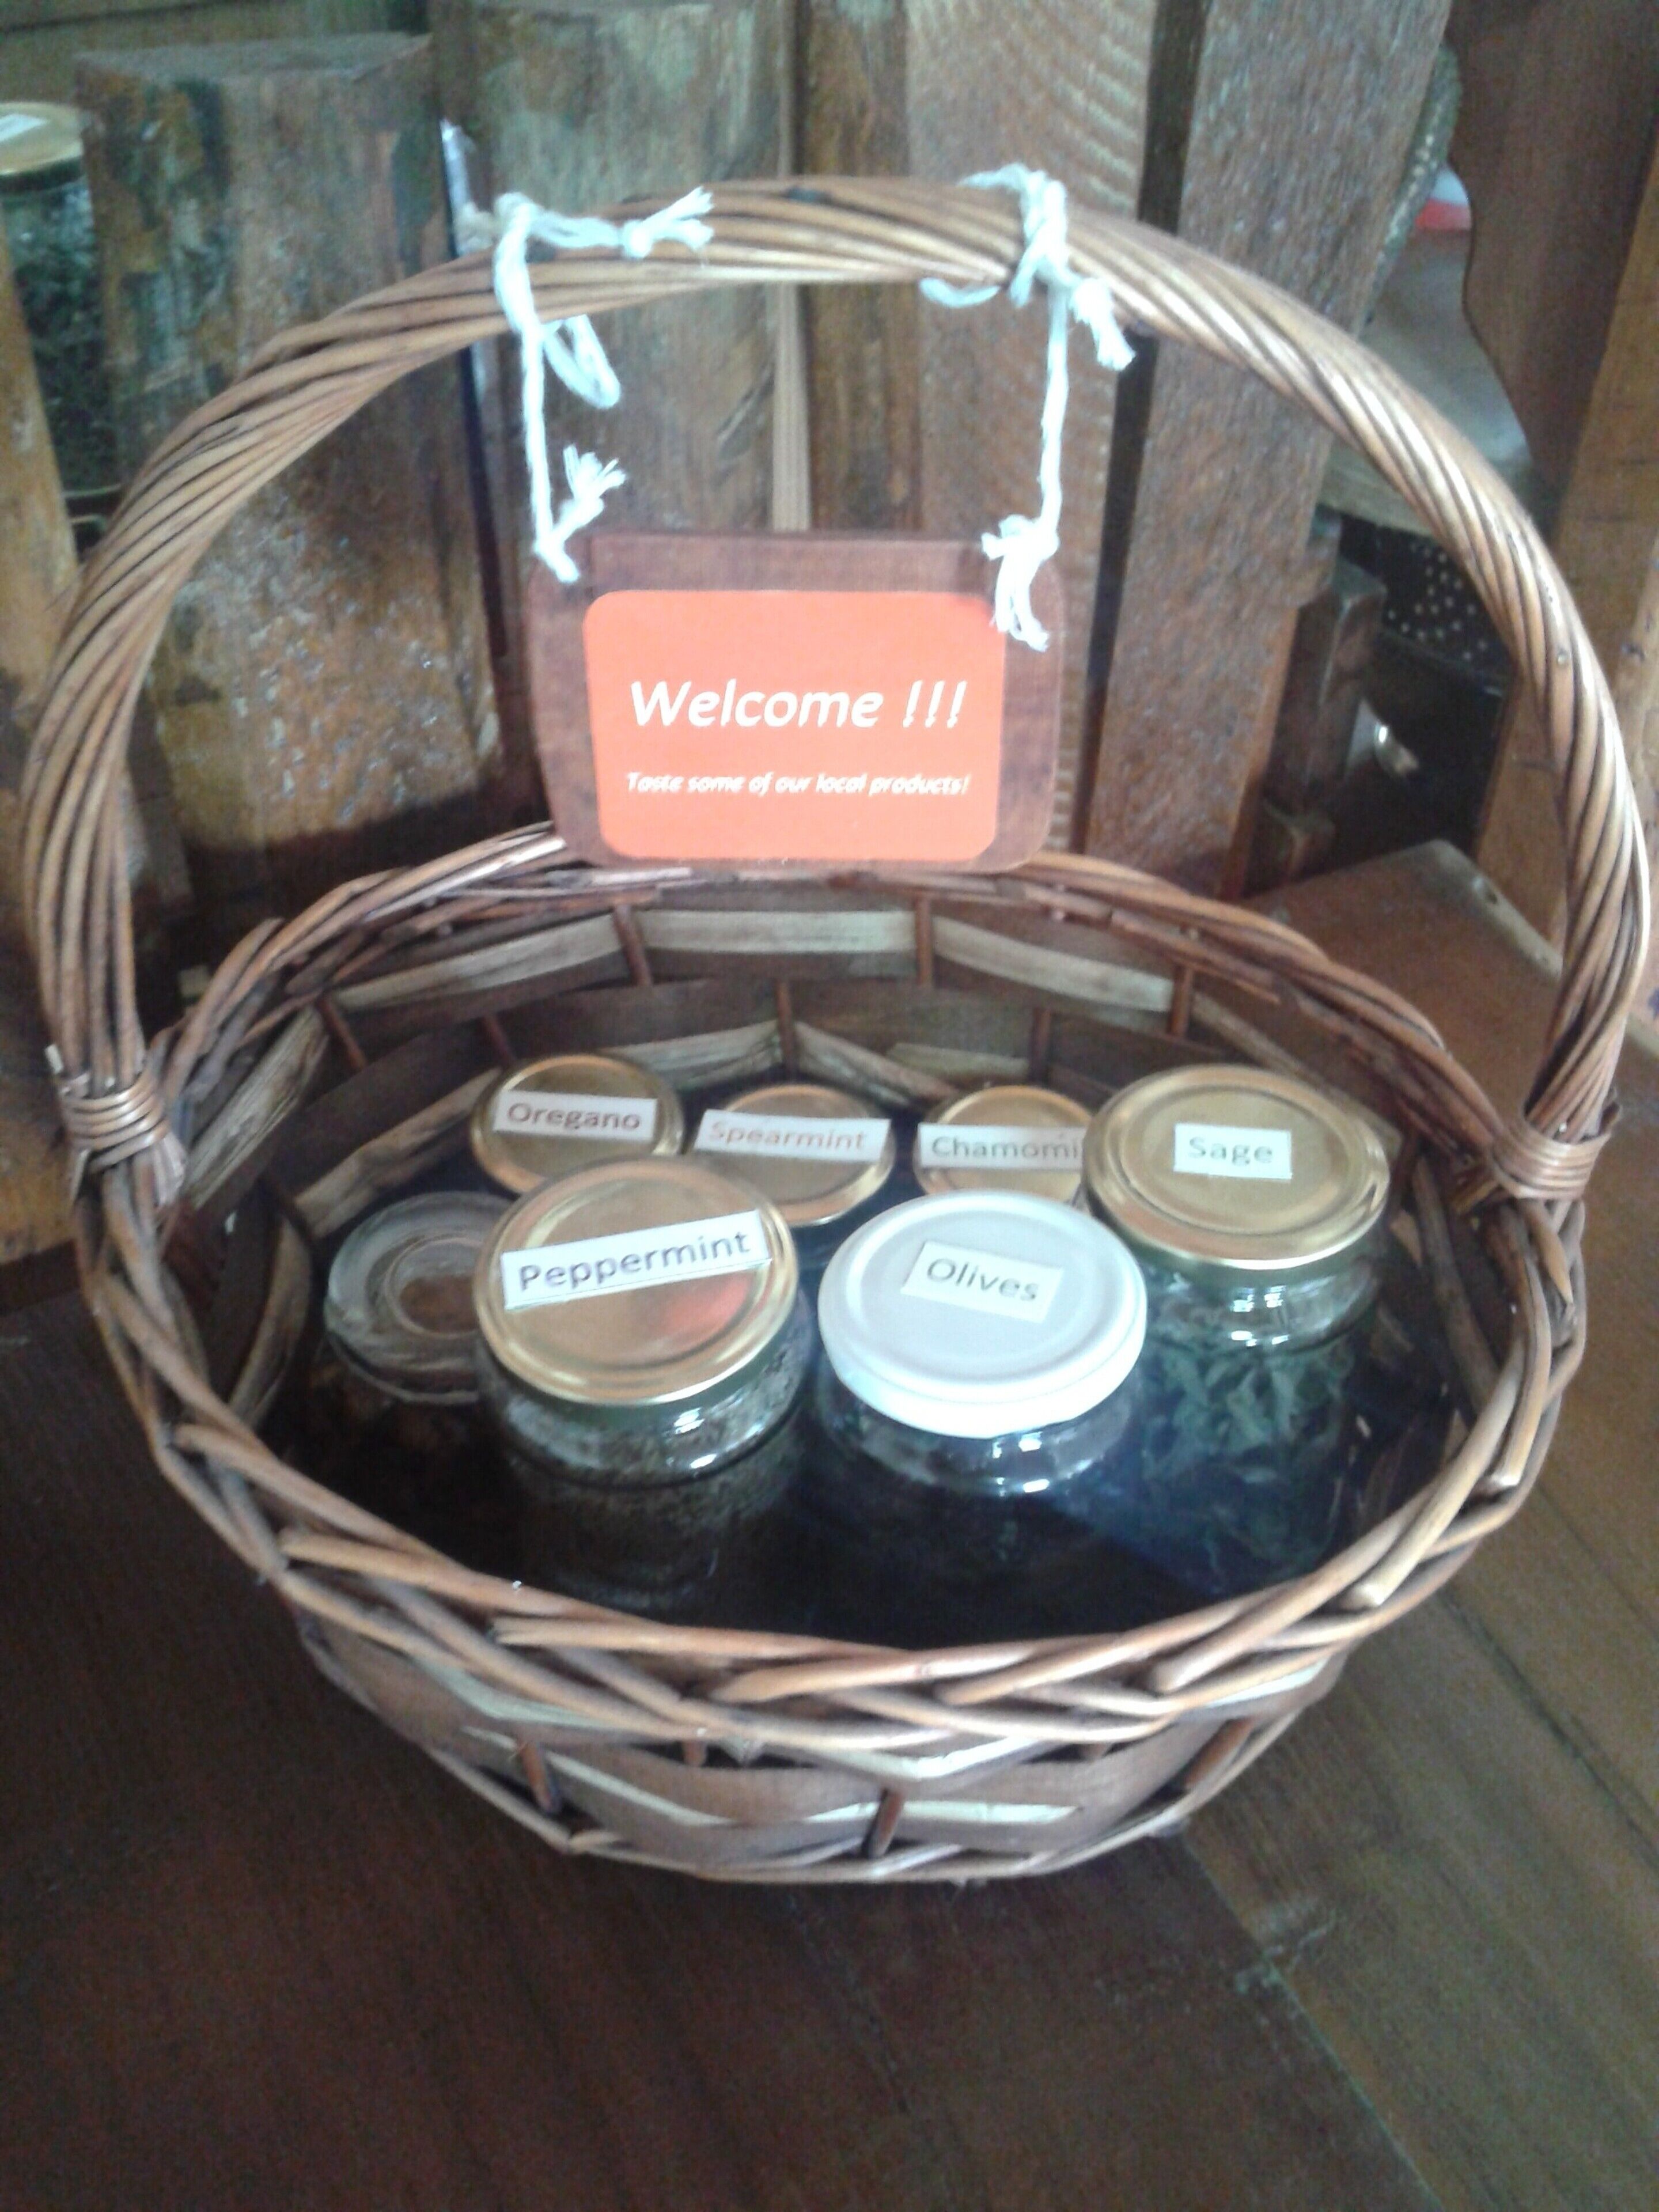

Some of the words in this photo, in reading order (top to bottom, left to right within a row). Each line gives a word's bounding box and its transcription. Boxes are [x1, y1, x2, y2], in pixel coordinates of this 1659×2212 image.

[630, 679, 884, 728] Welcome
[902, 680, 967, 729] !!!
[626, 772, 683, 793] Taste
[687, 776, 743, 793] some
[748, 772, 772, 795] of
[775, 777, 811, 793] our
[816, 772, 865, 793] local
[869, 774, 970, 796] products!
[507, 1102, 641, 1132] Oregano
[711, 1120, 867, 1153] Spearmint
[1188, 1136, 1272, 1165] Sage
[520, 1231, 751, 1293] Peppermint
[926, 1257, 1038, 1303] Olives
